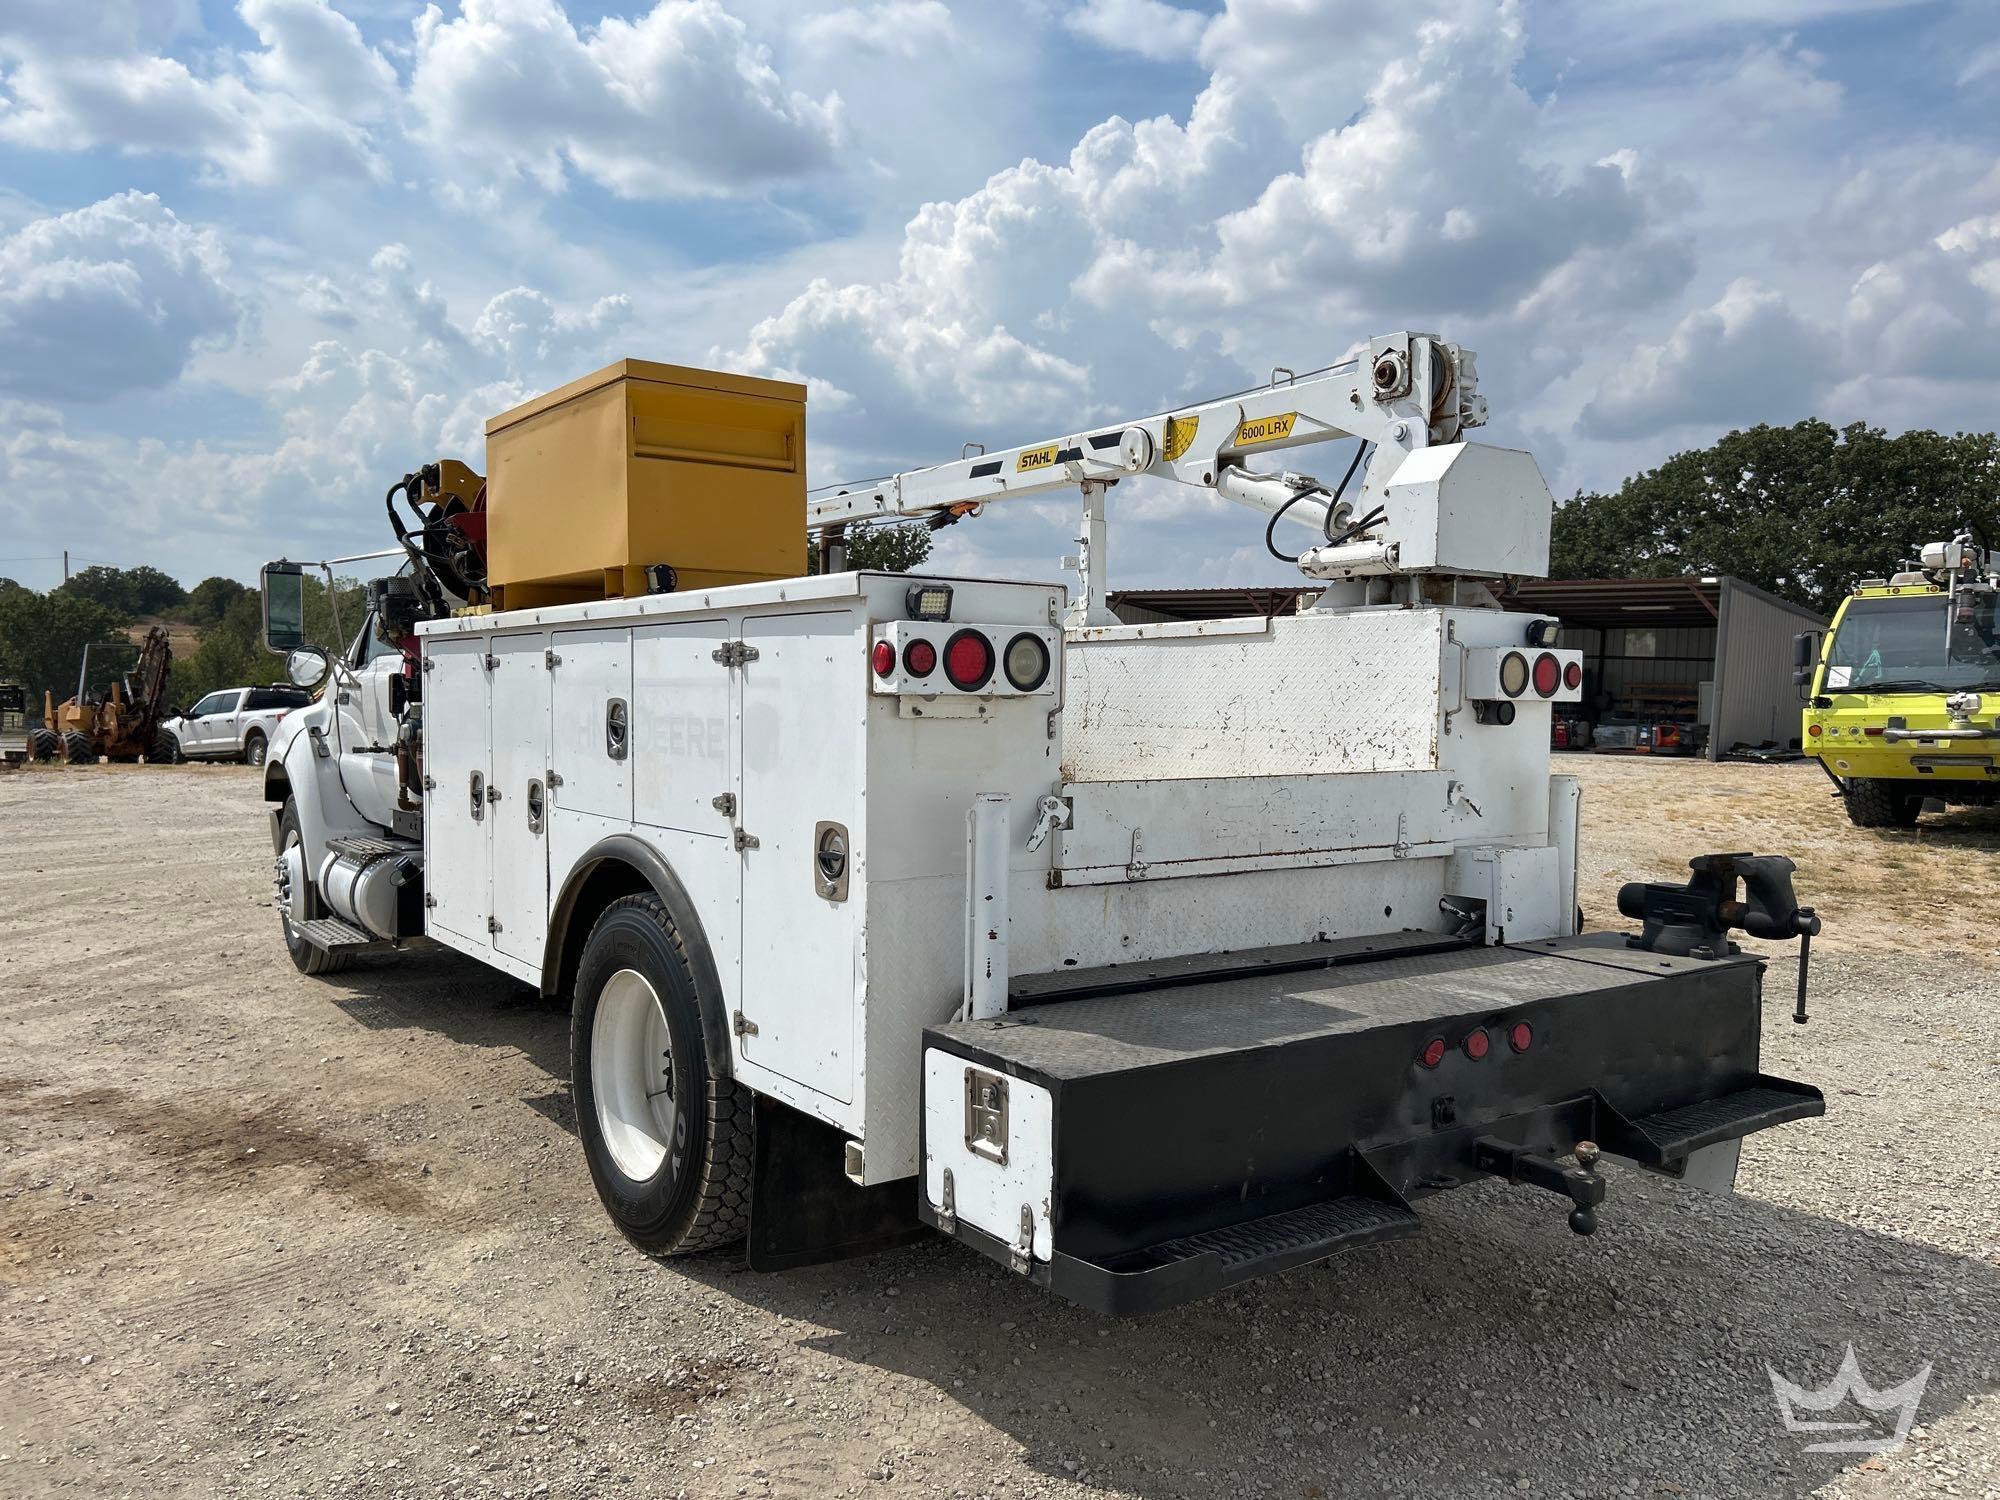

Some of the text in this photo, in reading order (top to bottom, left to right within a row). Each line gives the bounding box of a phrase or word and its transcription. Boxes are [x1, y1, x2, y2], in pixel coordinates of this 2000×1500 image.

[1242, 419, 1289, 440] 6000 LRX
[1021, 451, 1052, 468] STAHL
